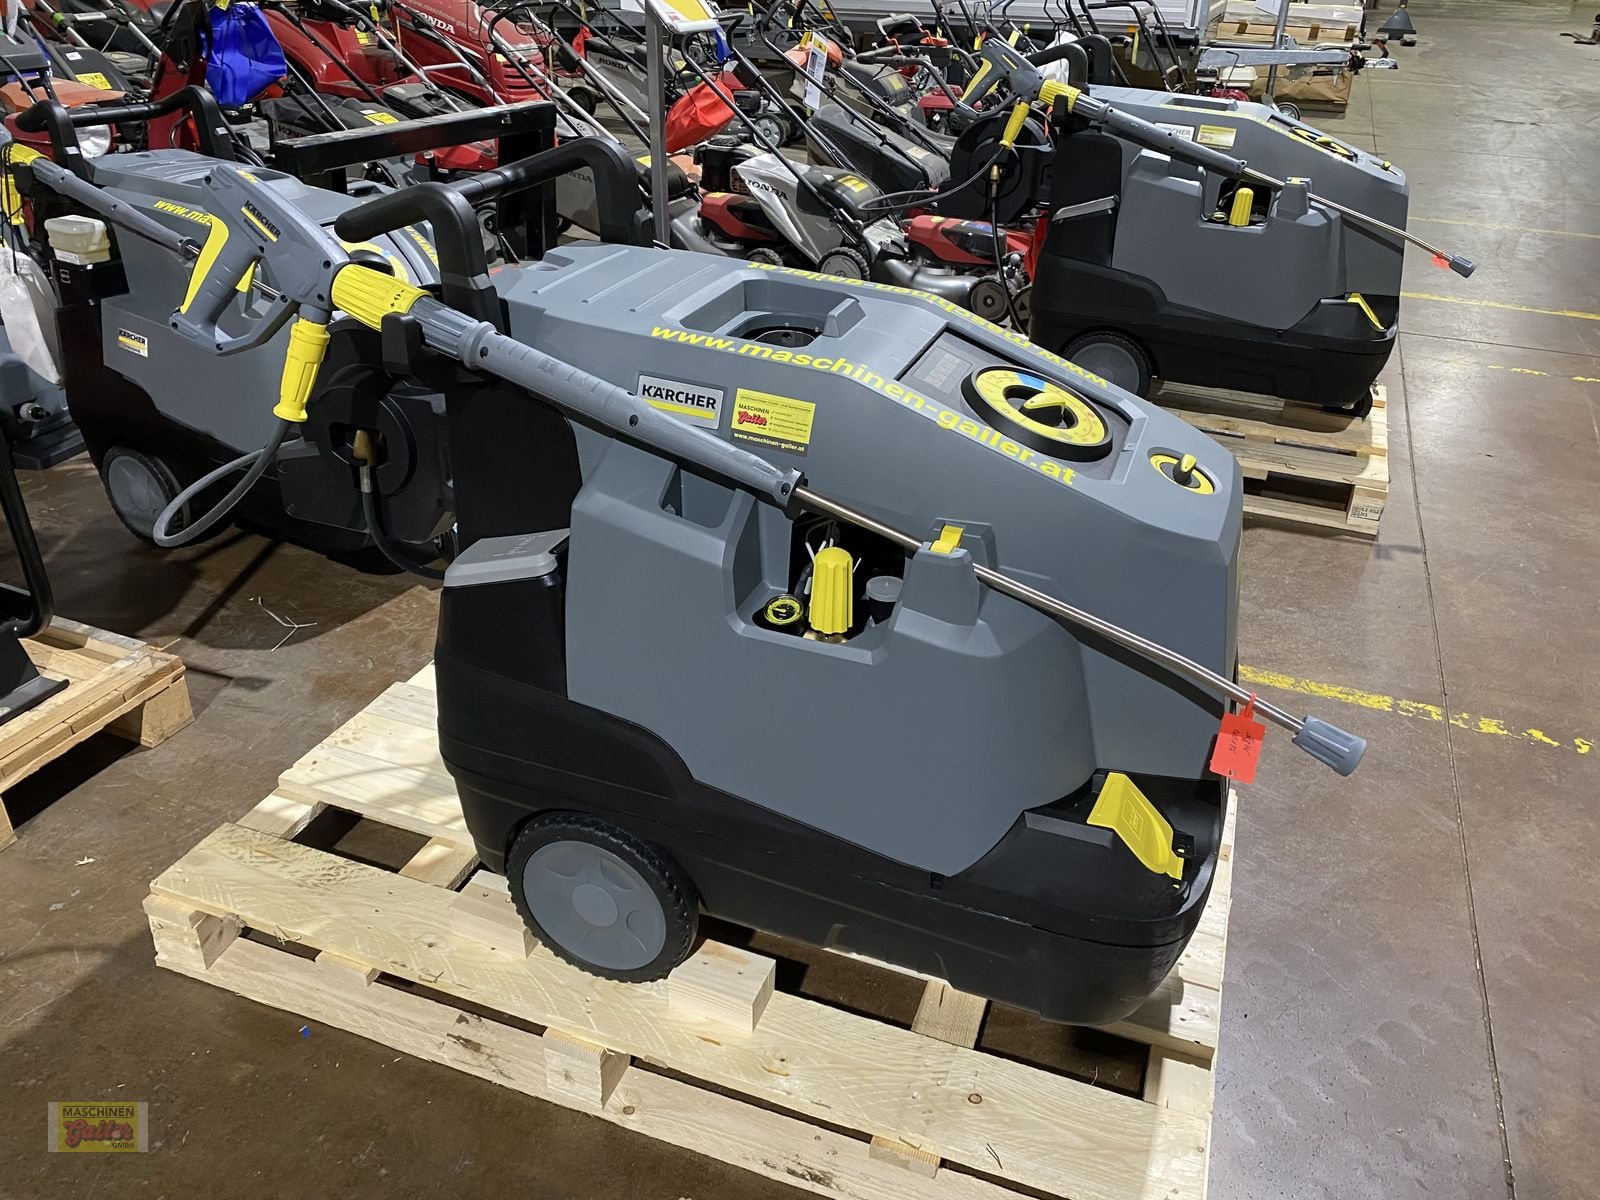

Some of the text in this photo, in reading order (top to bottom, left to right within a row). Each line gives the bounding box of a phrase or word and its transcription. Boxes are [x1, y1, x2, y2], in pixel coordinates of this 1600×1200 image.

[598, 57, 630, 73] HONDA
[244, 200, 282, 239] KÄRCHER
[745, 260, 1109, 389] www.maschinen-gailer.at
[118, 329, 146, 345] KÄRCHER
[641, 383, 717, 410] KÄRCHER
[650, 325, 1077, 486] www.maschinen-gailer.at
[738, 403, 770, 415] MASCHINEN
[733, 432, 805, 451] www.maschinen-gailer.at
